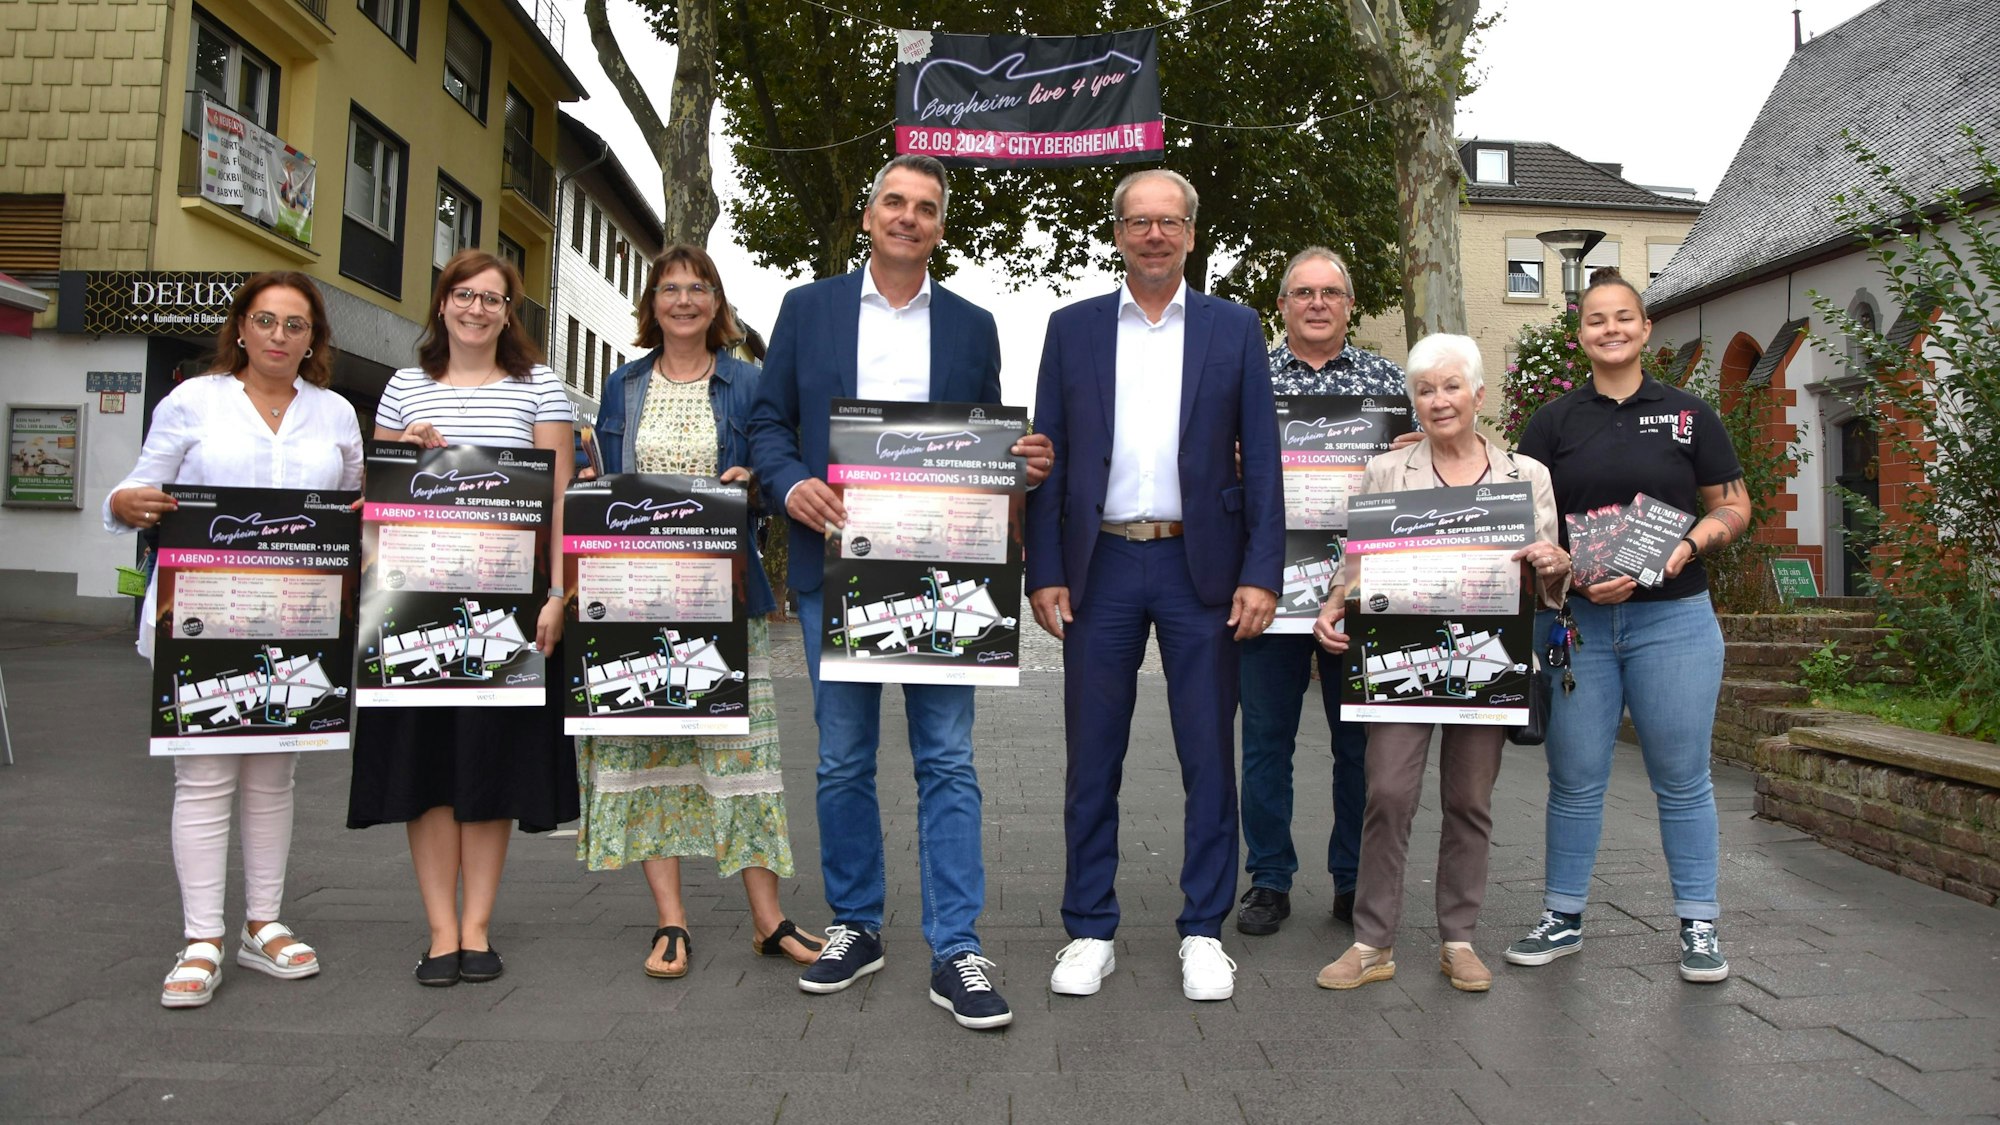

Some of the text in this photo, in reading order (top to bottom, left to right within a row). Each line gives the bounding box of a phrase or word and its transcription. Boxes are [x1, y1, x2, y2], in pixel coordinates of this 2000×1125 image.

[903, 39, 925, 54] EINTRITT
[920, 71, 1125, 125] Bergheim live 4 you
[908, 128, 1144, 155] 28.09.2024 CITY.BERGHEIM.DE
[132, 282, 244, 306] DELUX
[154, 313, 228, 323] Konditorei & Bäcker
[995, 419, 1022, 427] Bergheim
[1288, 433, 1325, 445] Bergheim
[1327, 428, 1342, 438] live
[1351, 426, 1365, 435] you
[880, 447, 924, 461] Bergheim
[927, 442, 944, 452] live
[955, 440, 972, 450] you
[923, 459, 934, 467] 28.
[936, 460, 981, 468] SEPTEMBER
[988, 461, 997, 469] 19
[1308, 455, 1356, 463] LOCATIONS
[839, 471, 1015, 485] 1 ABEND 12 LOCATIONS 13 BANDS
[414, 486, 456, 500] Bergheim
[459, 482, 475, 491] live
[485, 481, 501, 491] you
[330, 504, 352, 512] Berghei
[468, 498, 510, 506] SEPTEMBER
[526, 500, 542, 508] UHR
[375, 508, 541, 522] 1 ABEND 12 LOCATIONS 13 BANDS
[609, 516, 650, 530] Bergheim
[653, 511, 669, 521] live
[679, 509, 695, 519] you
[1394, 522, 1436, 534] Bergheim
[1438, 518, 1453, 526] live
[1465, 514, 1480, 522] you
[1447, 526, 1491, 534] SEPTEMBER
[213, 529, 259, 544] Bergheim
[261, 526, 279, 536] live
[290, 524, 307, 534] you
[258, 542, 269, 550] 28.
[271, 543, 316, 551] SEPTEMBER
[632, 541, 684, 549] LOCATIONS
[692, 541, 702, 549] 13
[705, 541, 737, 549] BANDS
[1364, 541, 1396, 549] ABEND
[1417, 537, 1470, 546] LOCATIONS
[1492, 534, 1525, 542] BANDS
[171, 554, 348, 566] 1 ABEND 12 LOCATIONS 13 BANDS
[1459, 712, 1508, 720] westenergie
[279, 738, 328, 748] westenergie
